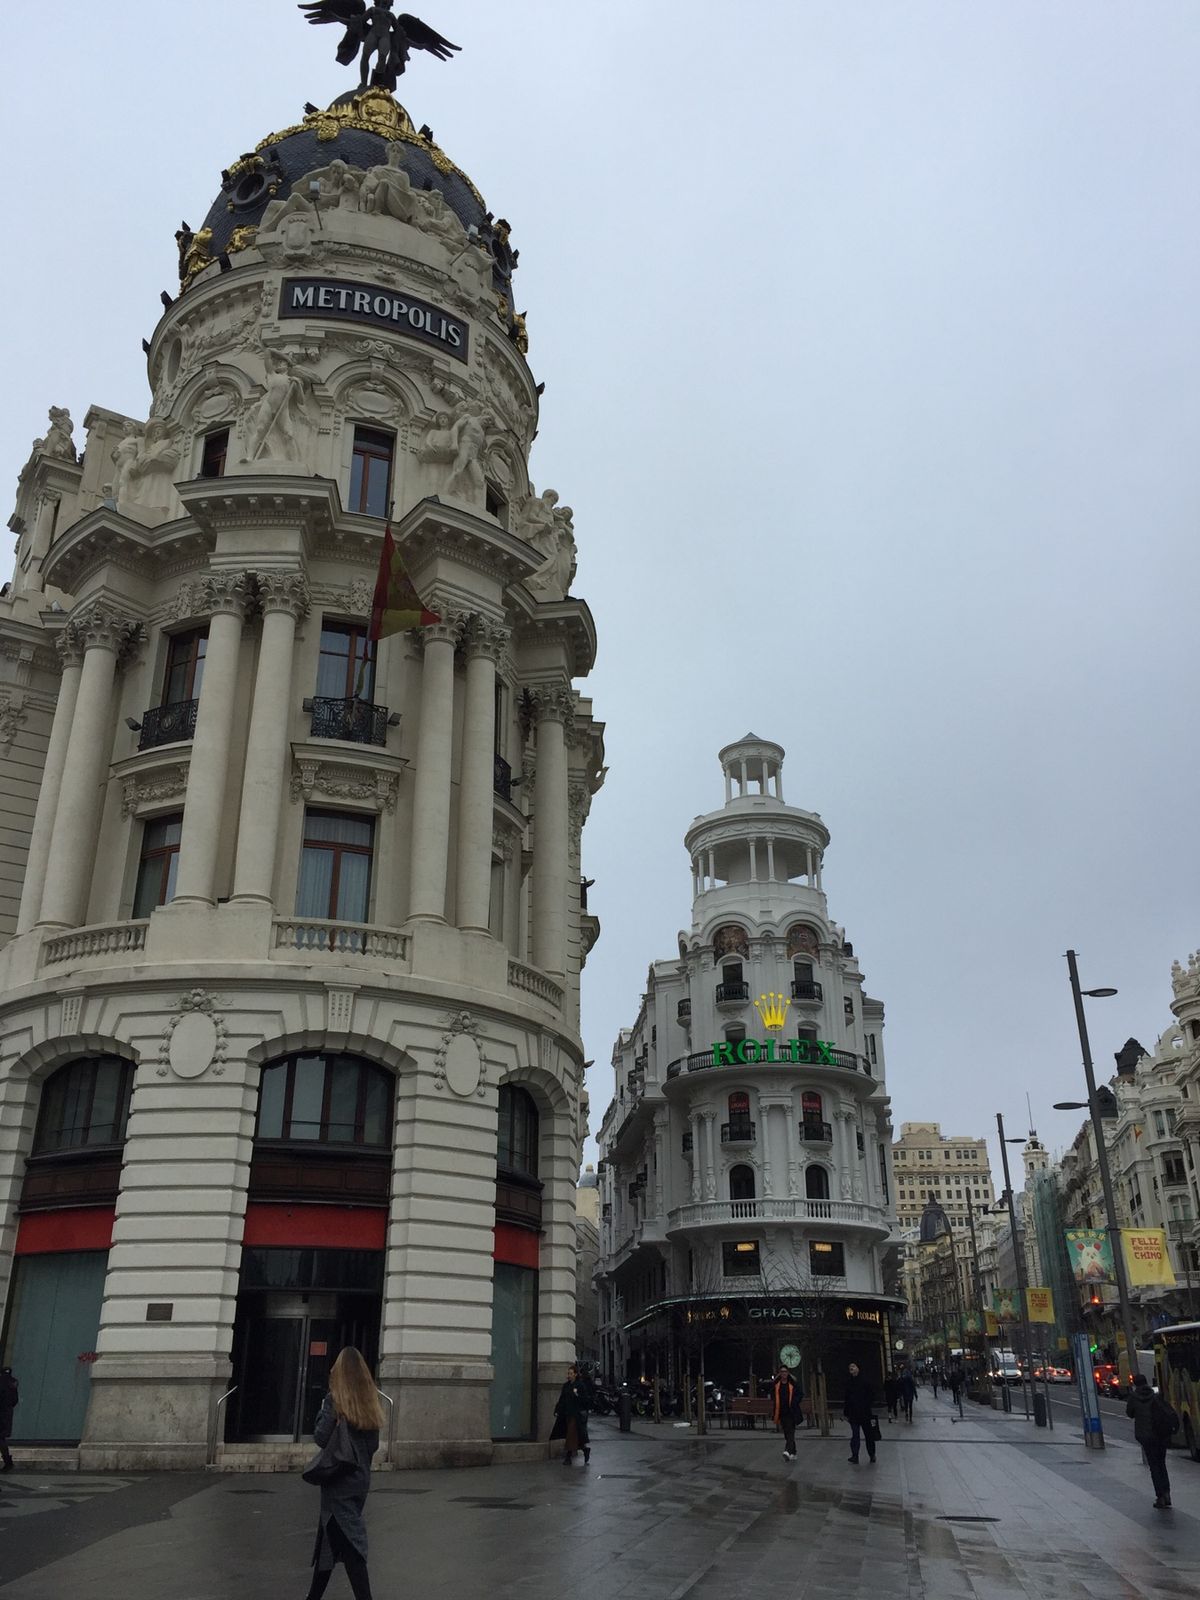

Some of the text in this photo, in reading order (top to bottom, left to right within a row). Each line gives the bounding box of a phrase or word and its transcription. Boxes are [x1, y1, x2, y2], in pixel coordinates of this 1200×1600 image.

[291, 286, 461, 348] METROPOLIS
[711, 1038, 838, 1067] ROLEX
[1131, 1237, 1160, 1246] FELIZ
[1134, 1251, 1162, 1260] CHINO
